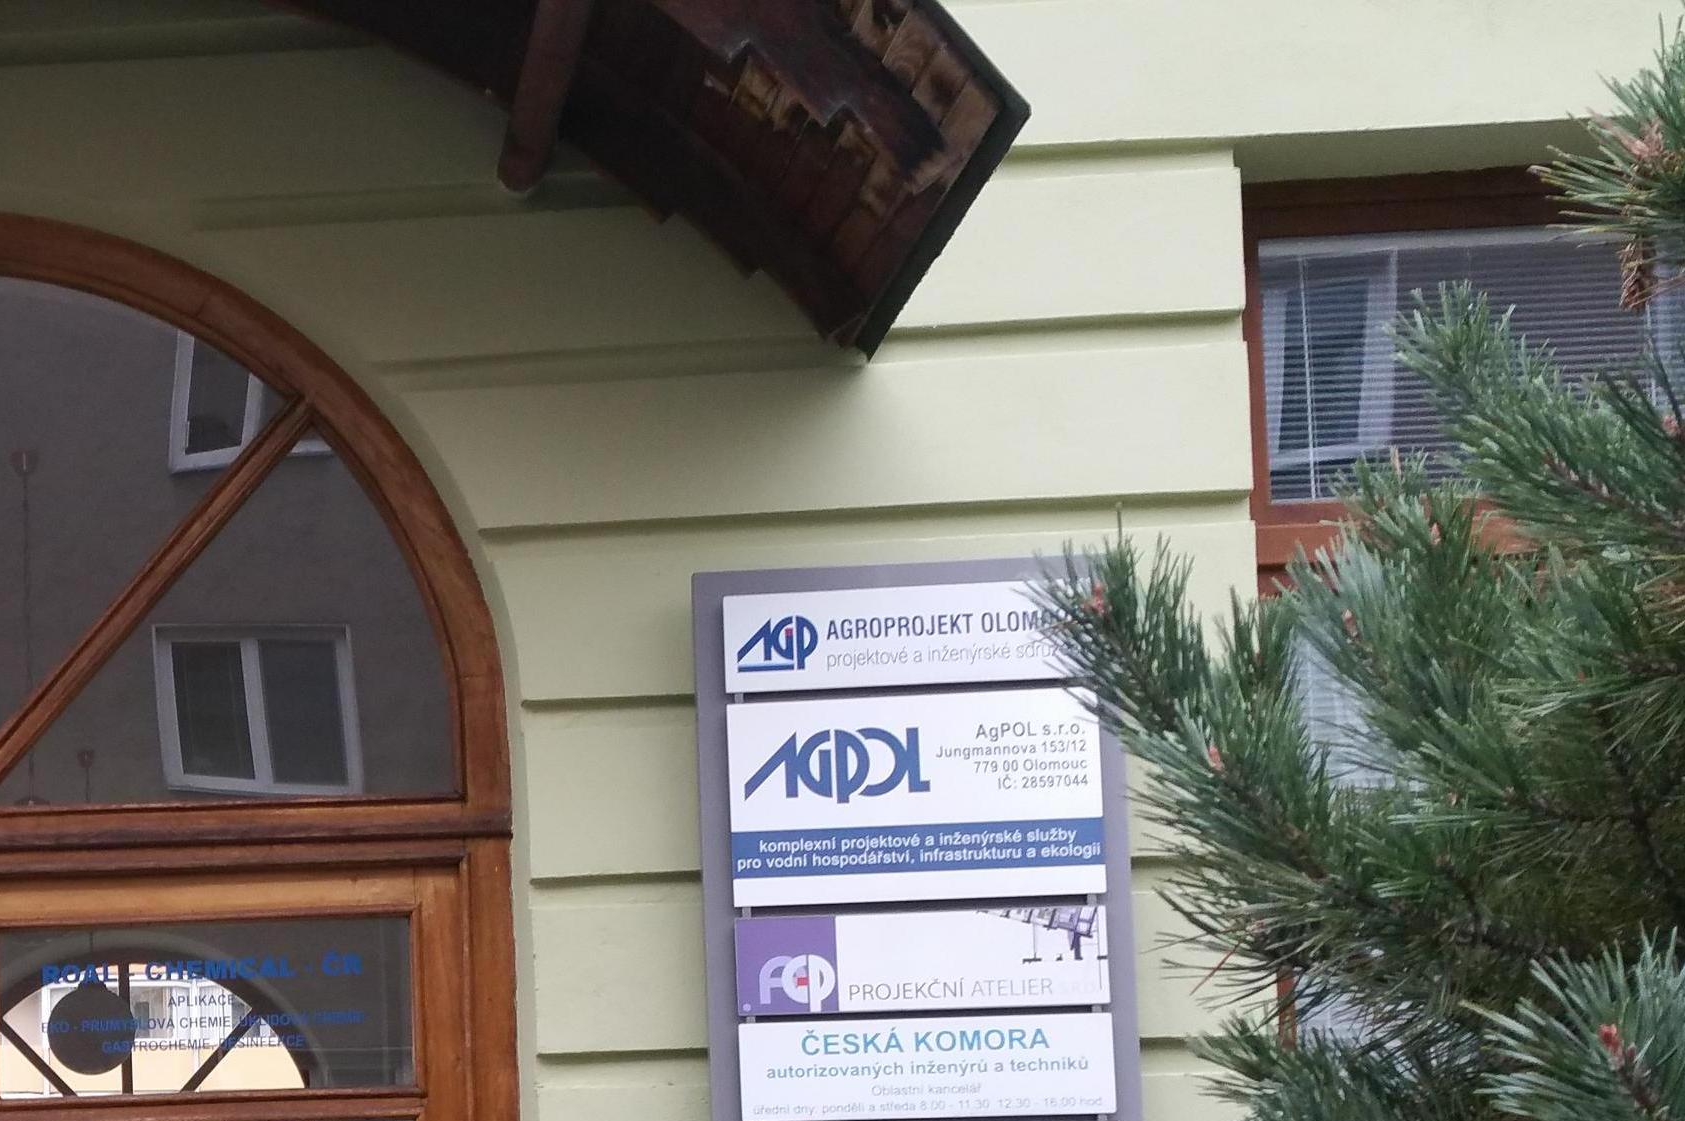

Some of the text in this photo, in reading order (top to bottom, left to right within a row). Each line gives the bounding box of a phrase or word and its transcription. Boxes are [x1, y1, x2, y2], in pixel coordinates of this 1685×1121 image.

[826, 613, 973, 640] AGROPROJEKT
[826, 643, 1010, 670] projektové a inženýrské
[976, 722, 1086, 742] AgPOL s.r.o.
[936, 738, 1088, 760] Jungmannova 153/12
[974, 757, 1088, 774] 779 00 Olomouc
[997, 773, 1088, 790] IČ: 28597044
[759, 827, 1077, 855] komplexní projektové a inženýrské služby
[737, 842, 1101, 872] pro vodní hospodářství, infrastrukturu a ekologii
[145, 956, 295, 980] CHEMICAL
[168, 993, 234, 1008] APLIKACE
[849, 977, 965, 1001] PROJEKČNÍ
[971, 978, 1053, 998] ATELIER
[801, 1027, 1050, 1056] ČESKÁ KOMORA
[766, 1055, 1089, 1080] autorizovaných inženýrů a techniků
